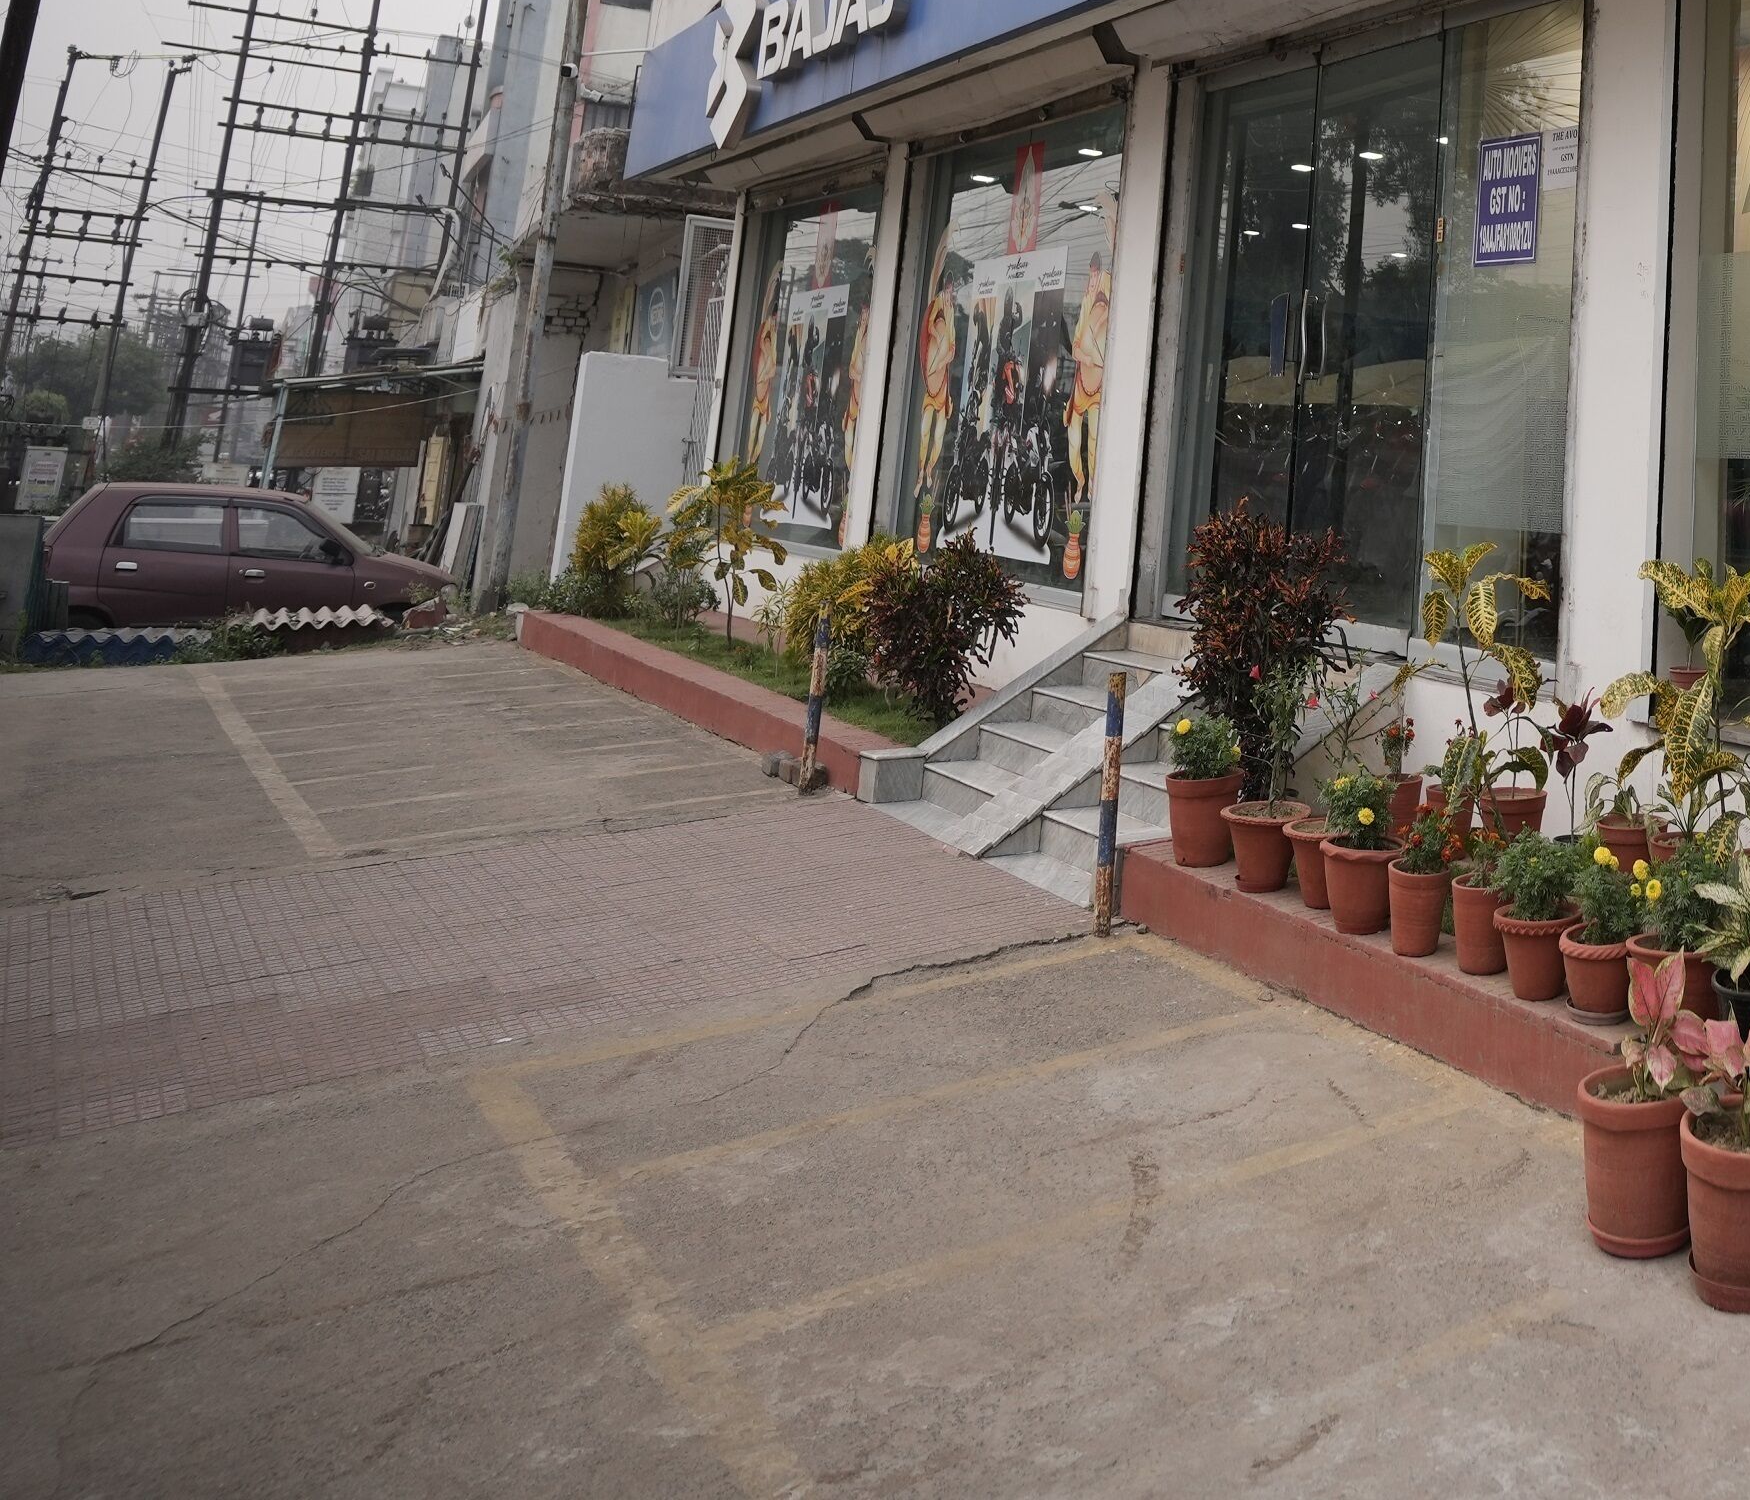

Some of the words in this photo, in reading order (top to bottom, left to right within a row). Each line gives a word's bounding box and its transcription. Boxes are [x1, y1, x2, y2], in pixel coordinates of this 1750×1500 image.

[1552, 131, 1565, 142] THE
[1483, 148, 1502, 181] AUTO
[1503, 143, 1537, 179] MOOVERS
[1489, 187, 1507, 215] GST
